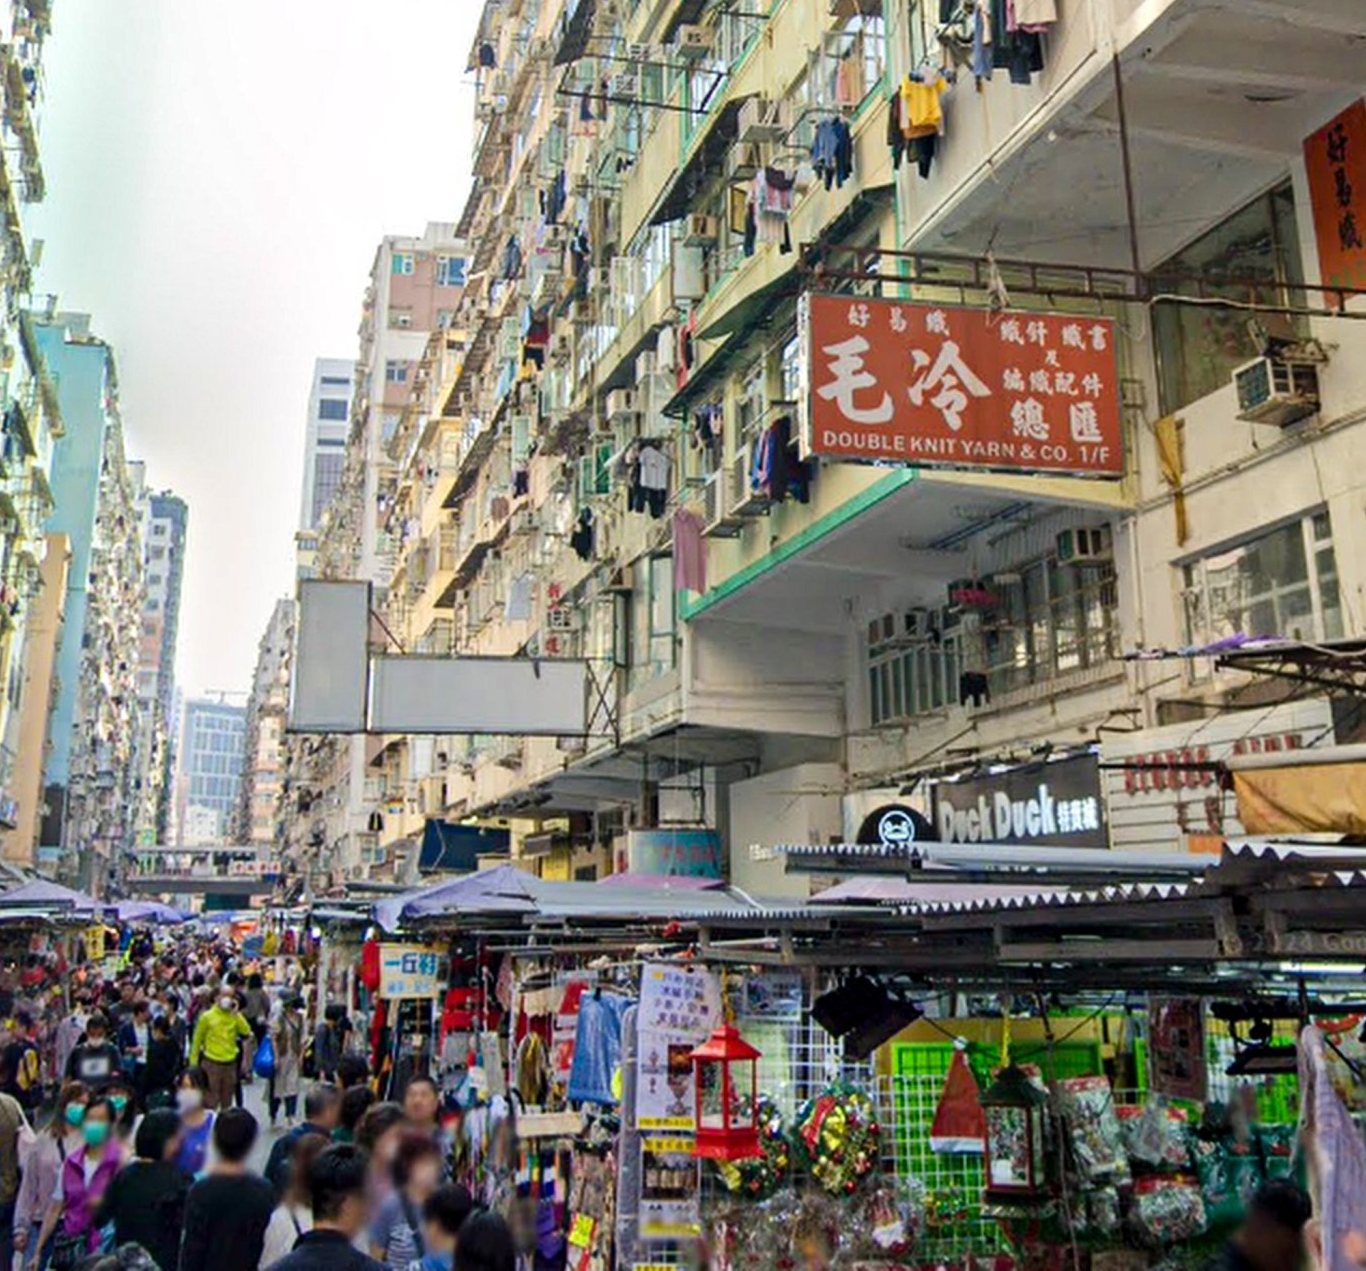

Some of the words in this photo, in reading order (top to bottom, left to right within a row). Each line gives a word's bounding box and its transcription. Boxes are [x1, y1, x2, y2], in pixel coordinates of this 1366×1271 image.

[816, 334, 992, 431] 毛冷
[1044, 349, 1062, 369] 及
[1009, 396, 1104, 443] 總匯
[822, 430, 905, 452] DOUBLE
[910, 436, 956, 454] KNIT
[960, 439, 1016, 459] YARN
[1019, 443, 1036, 461] &
[1079, 445, 1110, 465] 1/F
[938, 795, 993, 843] Duck
[994, 783, 1056, 839] Duck
